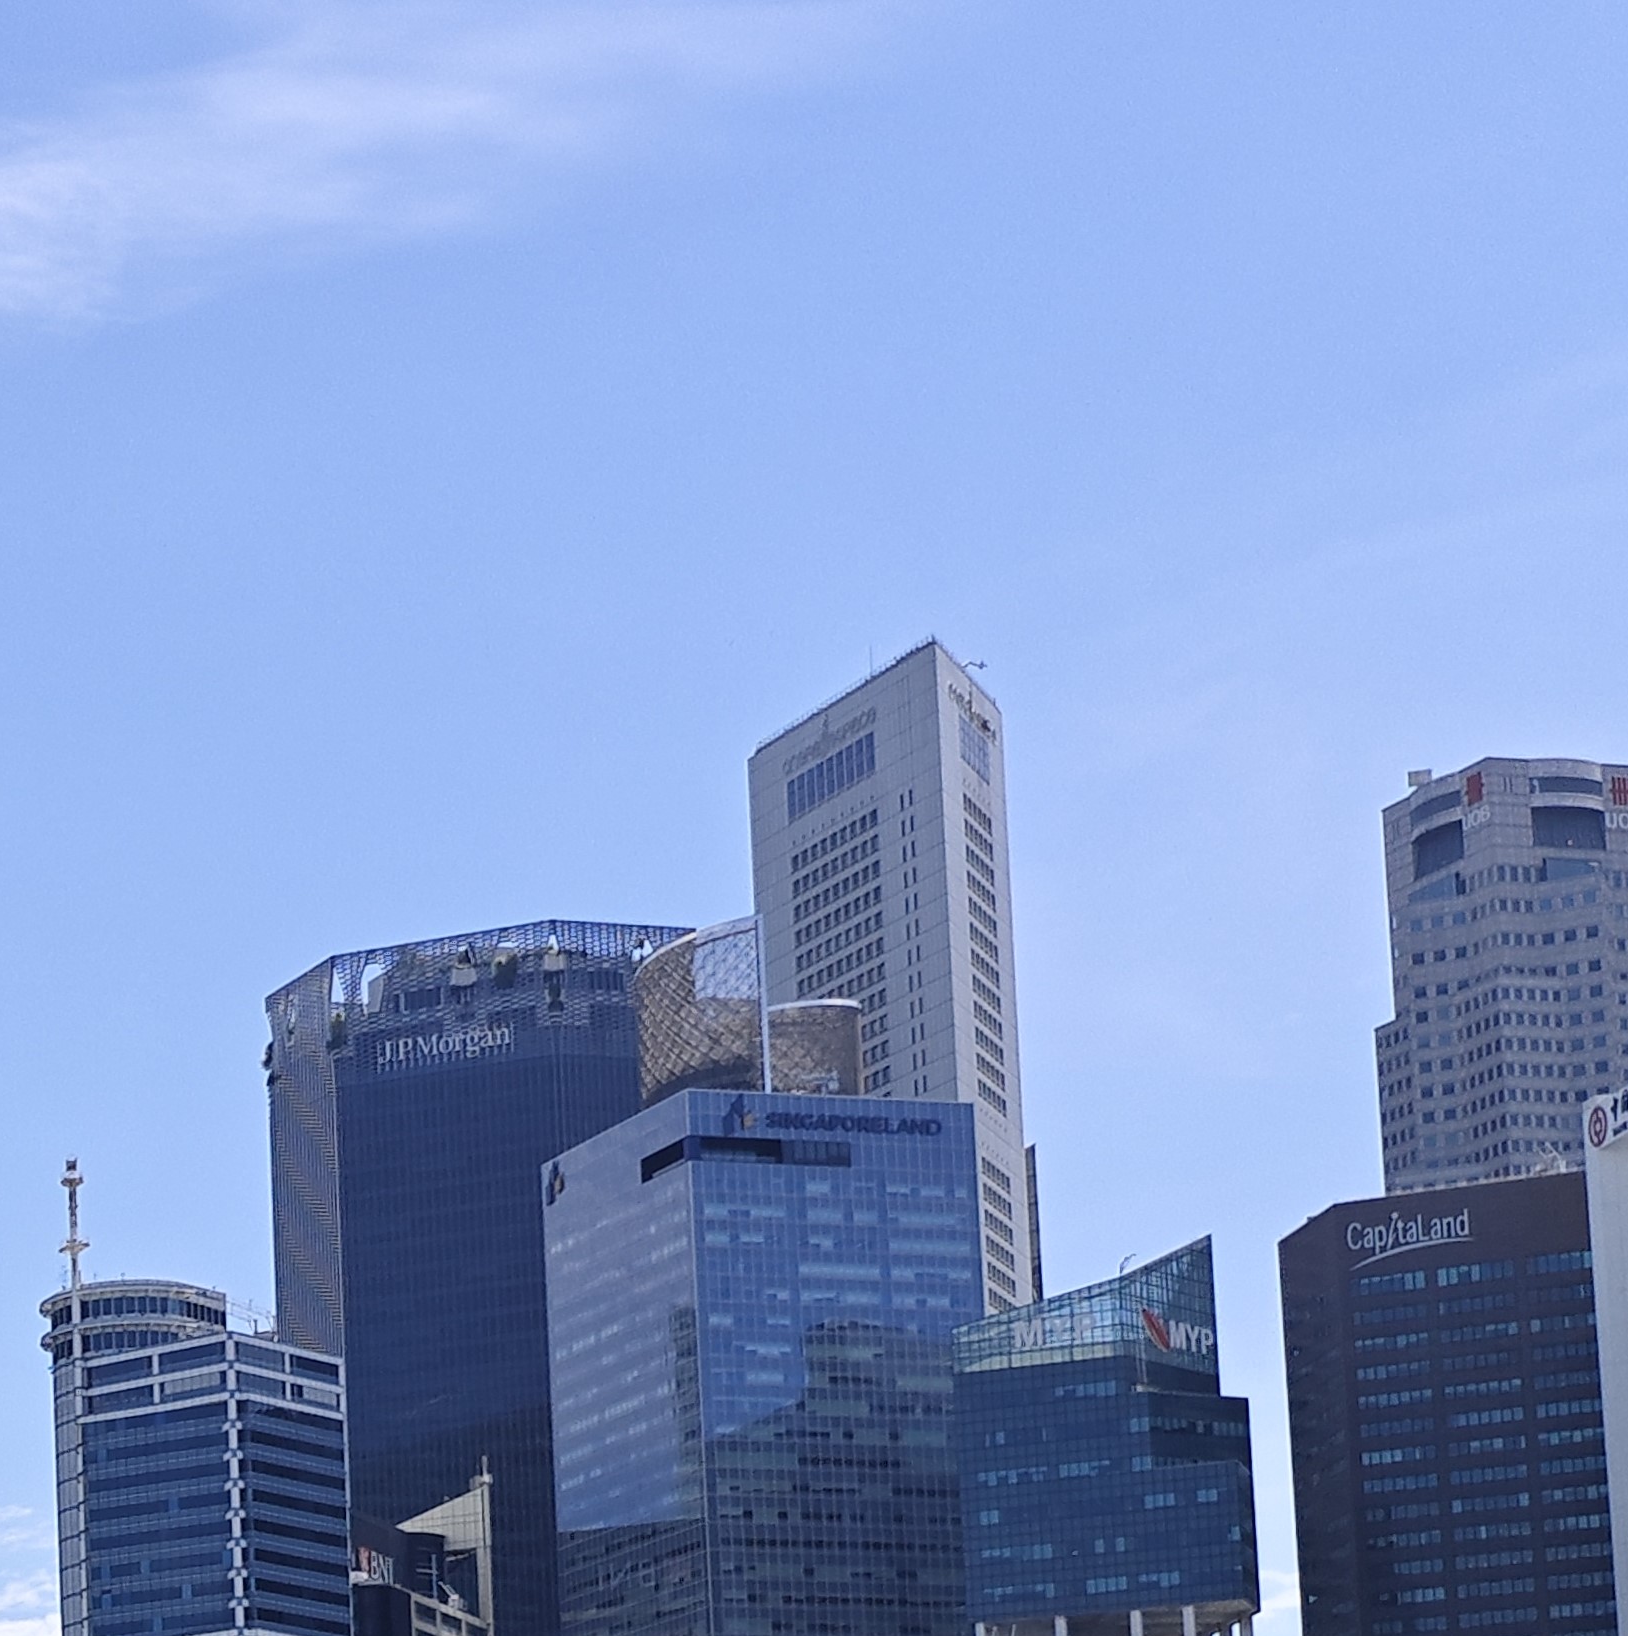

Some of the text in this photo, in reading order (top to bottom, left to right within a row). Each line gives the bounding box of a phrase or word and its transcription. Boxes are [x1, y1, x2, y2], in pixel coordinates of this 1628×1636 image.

[1347, 1208, 1470, 1255] CapitaLand
[1014, 1314, 1097, 1349] MYP
[1168, 1319, 1213, 1354] MYP
